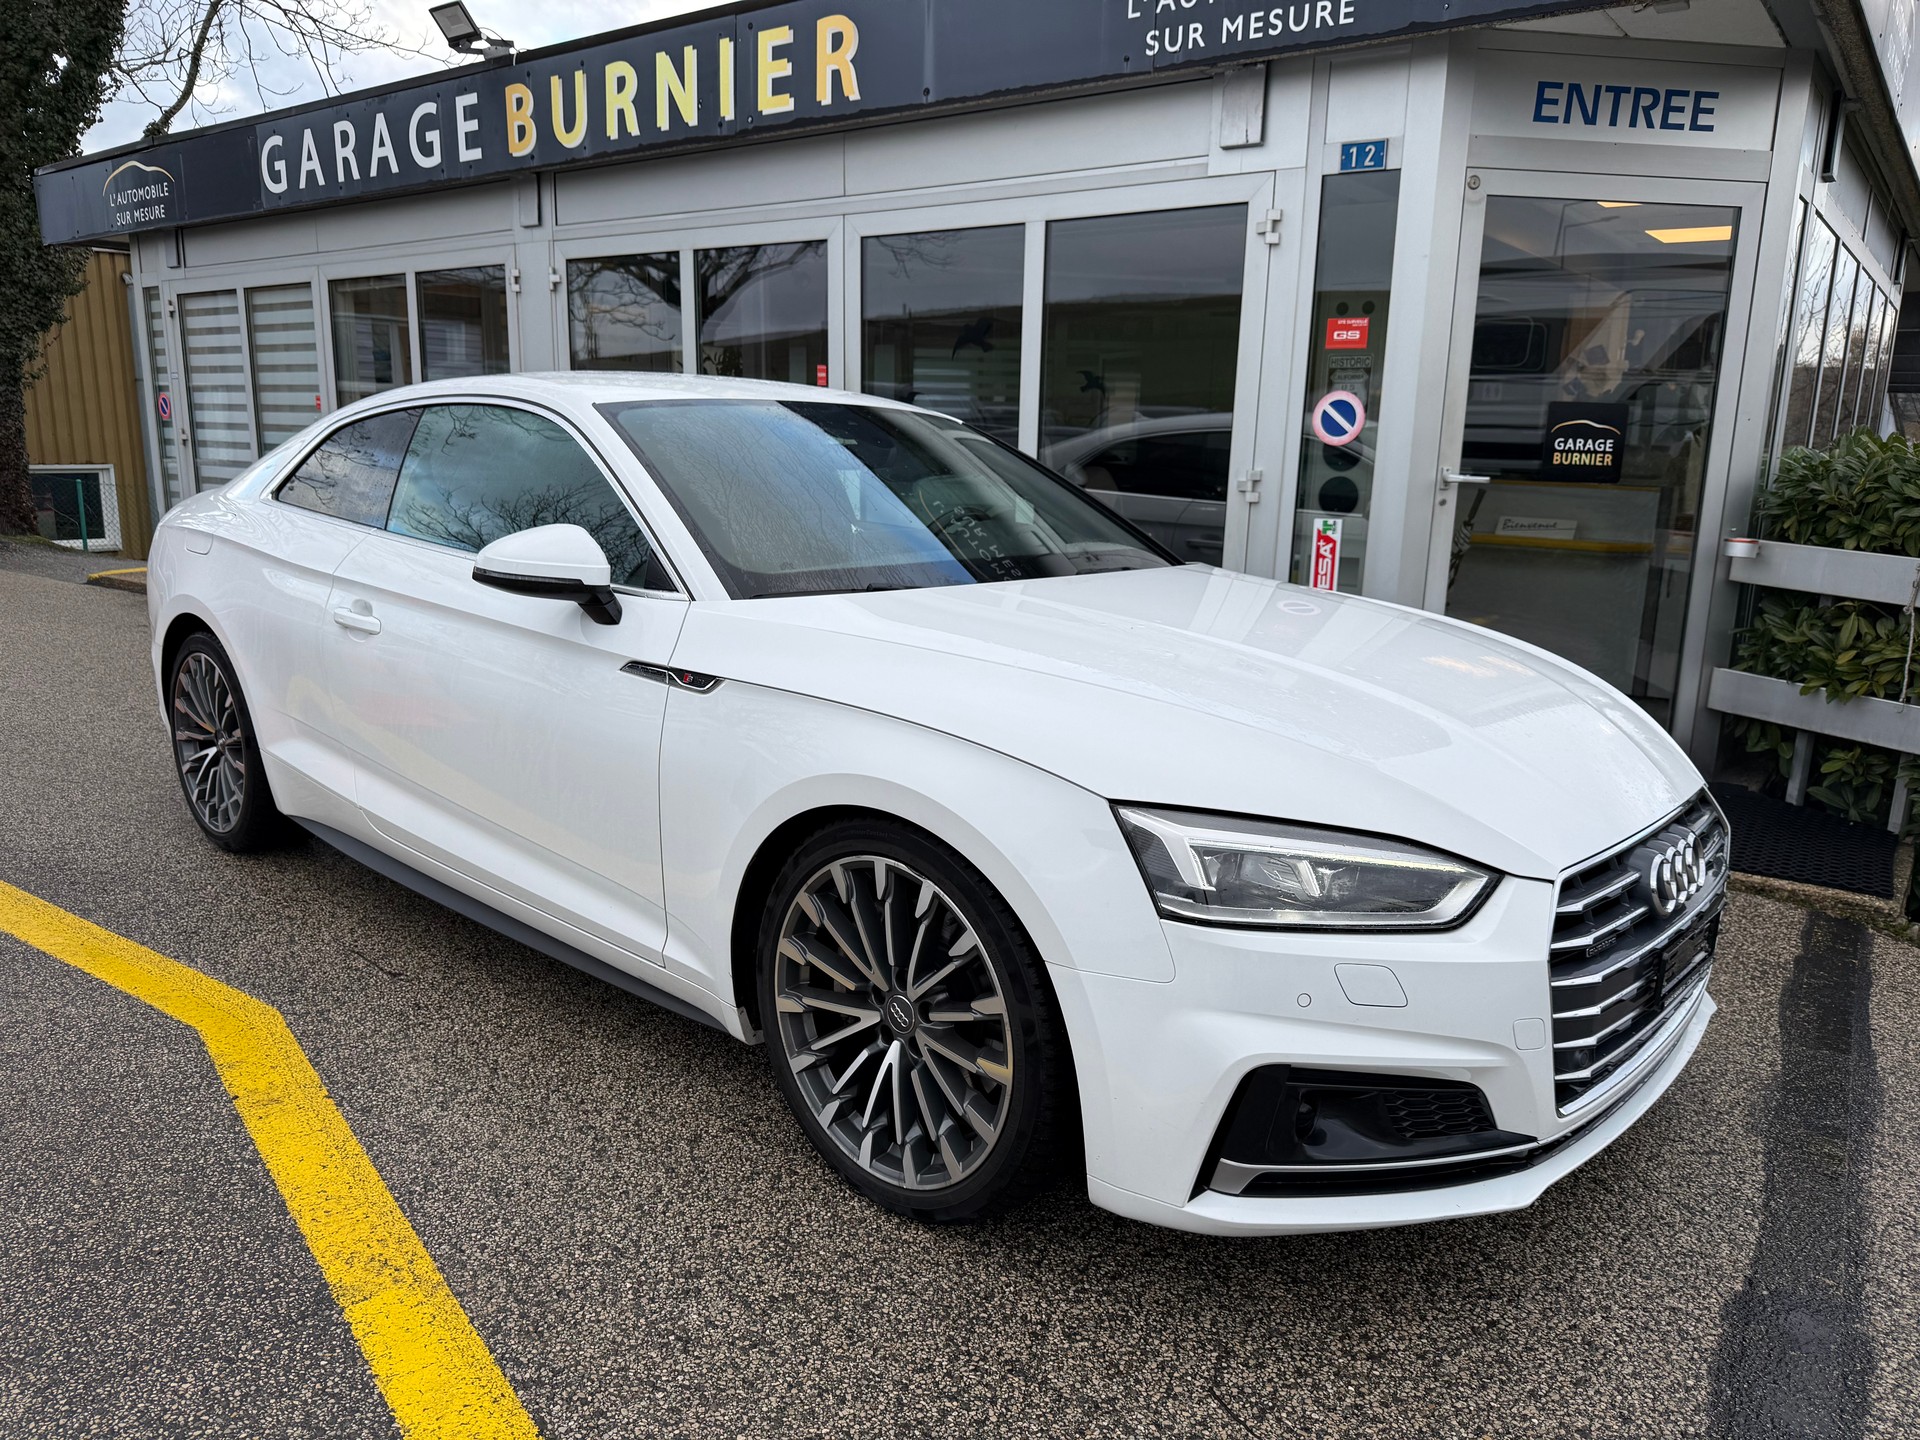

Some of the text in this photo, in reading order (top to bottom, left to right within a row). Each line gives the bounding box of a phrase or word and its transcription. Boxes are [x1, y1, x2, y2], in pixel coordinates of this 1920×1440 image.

[1145, 22, 1206, 56] SUR
[1221, 0, 1356, 44] MESURE
[261, 14, 861, 194] GARAGE BURNIER
[1532, 80, 1720, 132] ENTREE
[1349, 144, 1375, 168] 12
[109, 182, 169, 207] L'AUTOMOBILE
[116, 204, 166, 226] SUR MESURE
[1333, 330, 1360, 340] GS
[1331, 356, 1370, 367] HISTORIC
[1554, 437, 1614, 452] GARAGE
[1552, 452, 1612, 466] BURNIER
